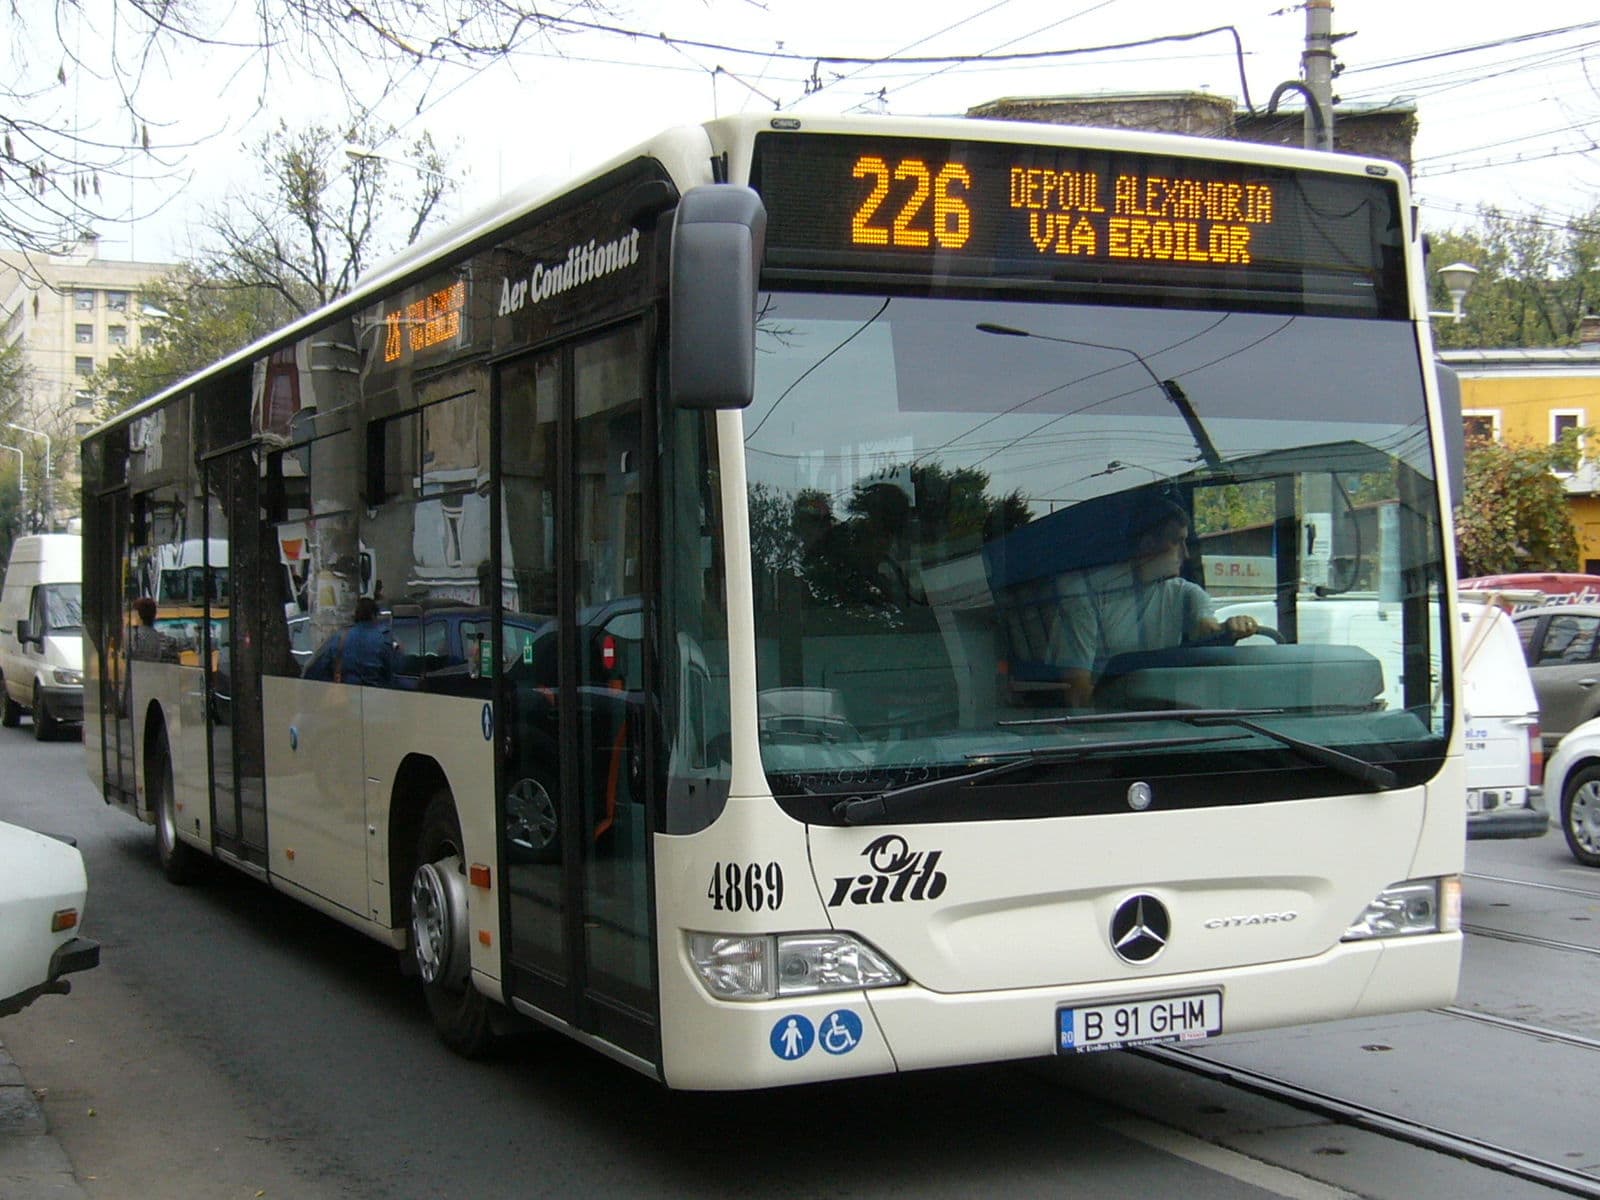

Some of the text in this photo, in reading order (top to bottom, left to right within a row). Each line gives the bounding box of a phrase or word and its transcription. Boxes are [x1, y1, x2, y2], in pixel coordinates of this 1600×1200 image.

[852, 157, 971, 248] 226
[1010, 167, 1273, 224] DEPOUL ALEXANDRIA
[1029, 213, 1251, 264] VIA EROILOR
[498, 276, 528, 317] Aer
[531, 227, 640, 304] Conditionat
[1213, 561, 1261, 577] S.R.L.
[708, 861, 784, 913] 4869
[1204, 911, 1297, 930] CITARO
[1061, 1031, 1074, 1044] RO
[1084, 999, 1206, 1042] B 91 GHM
